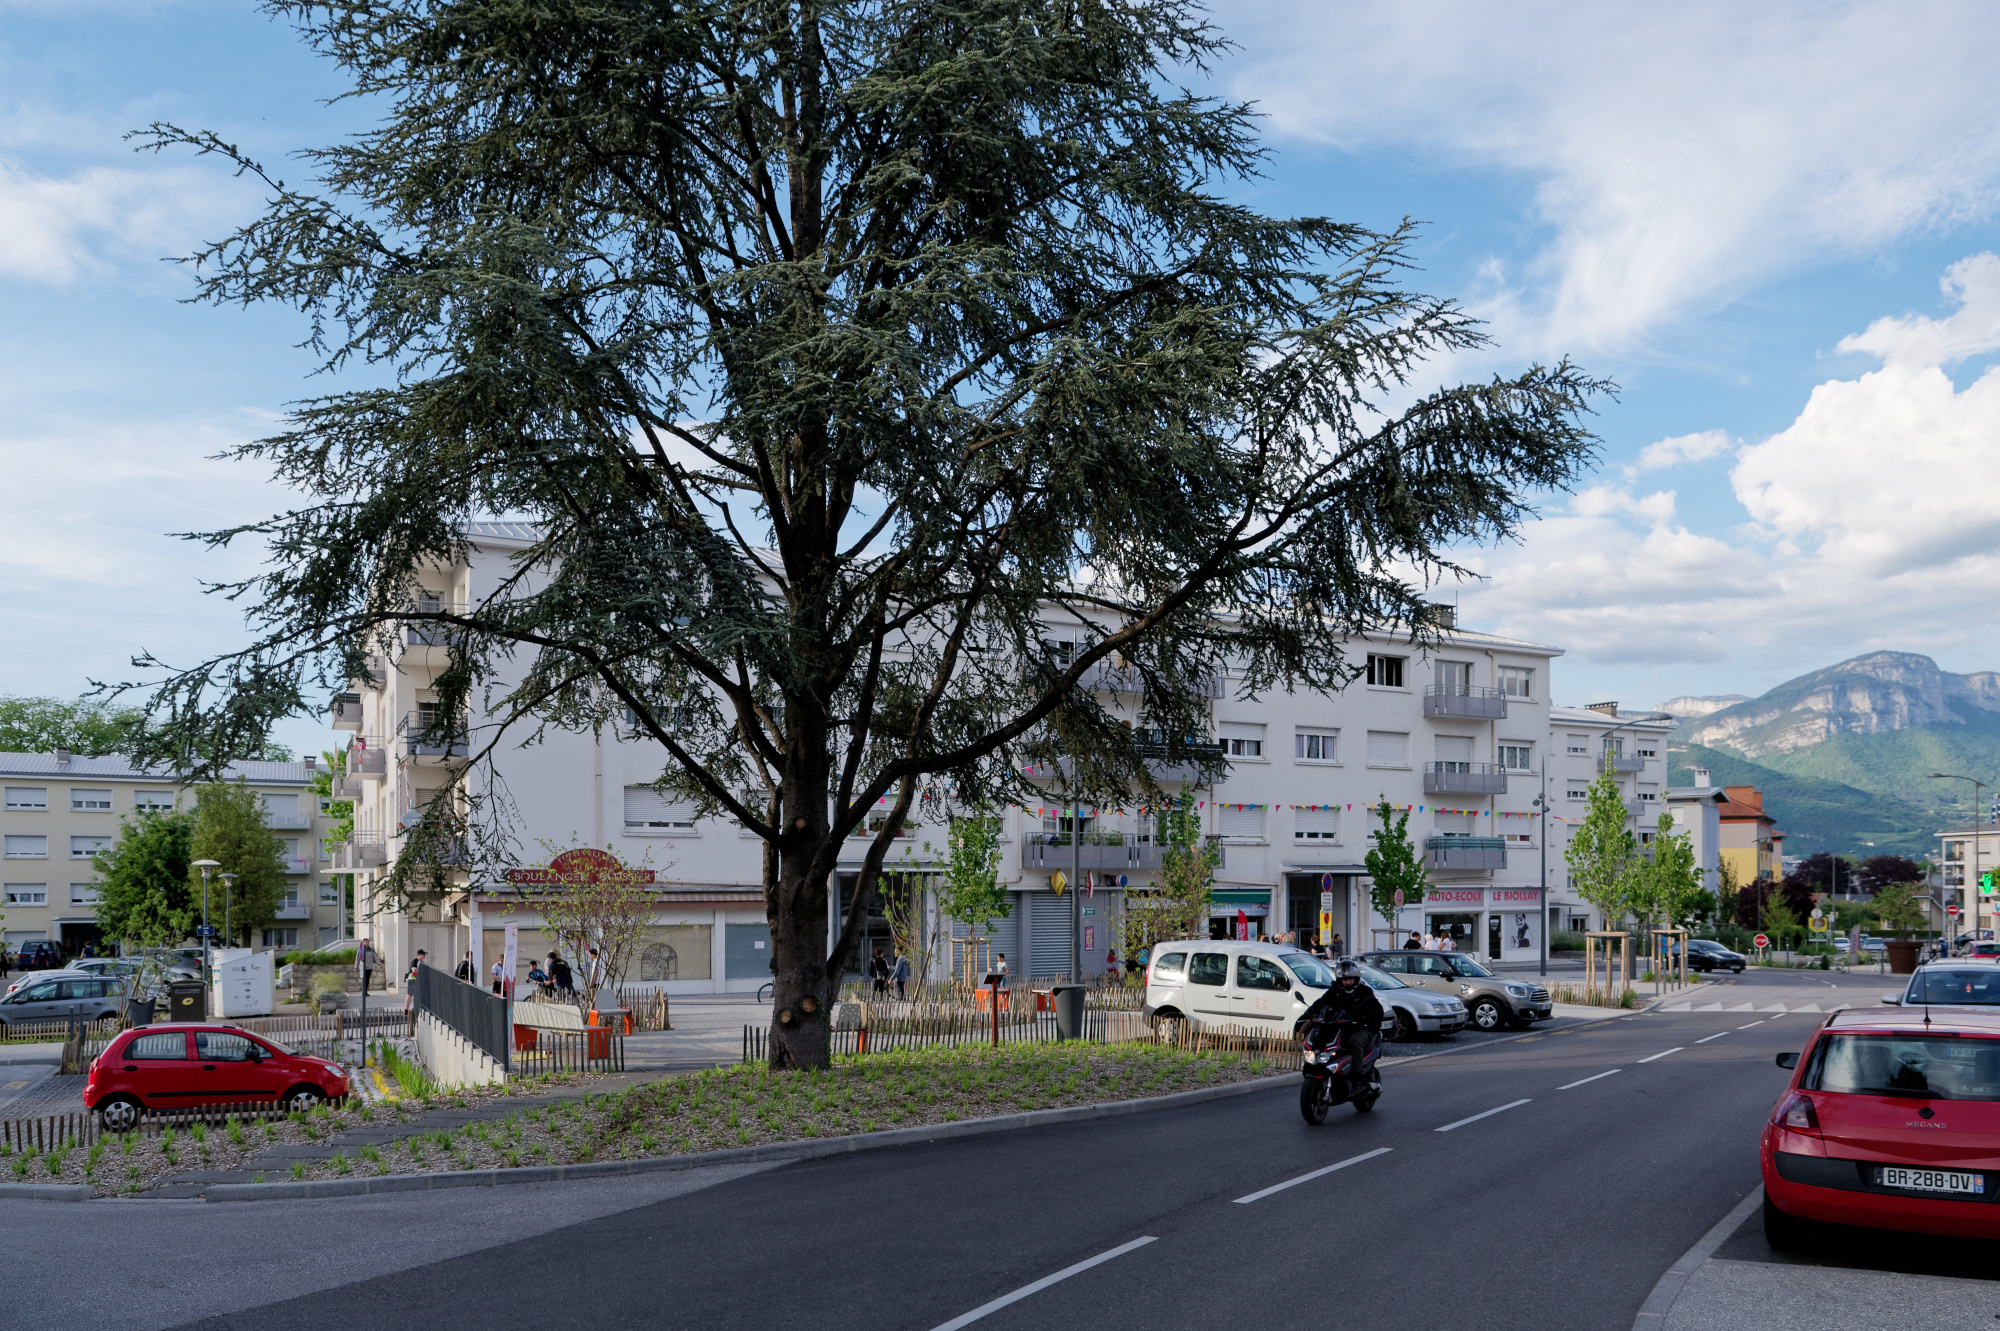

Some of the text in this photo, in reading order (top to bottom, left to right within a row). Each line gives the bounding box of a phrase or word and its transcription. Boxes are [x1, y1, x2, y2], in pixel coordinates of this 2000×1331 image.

[1427, 891, 1539, 901] AUTO-ECOLE LE BIOLLAY
[1905, 1121, 1947, 1129] MEGANE
[1887, 1169, 1970, 1190] BR-288-DV
